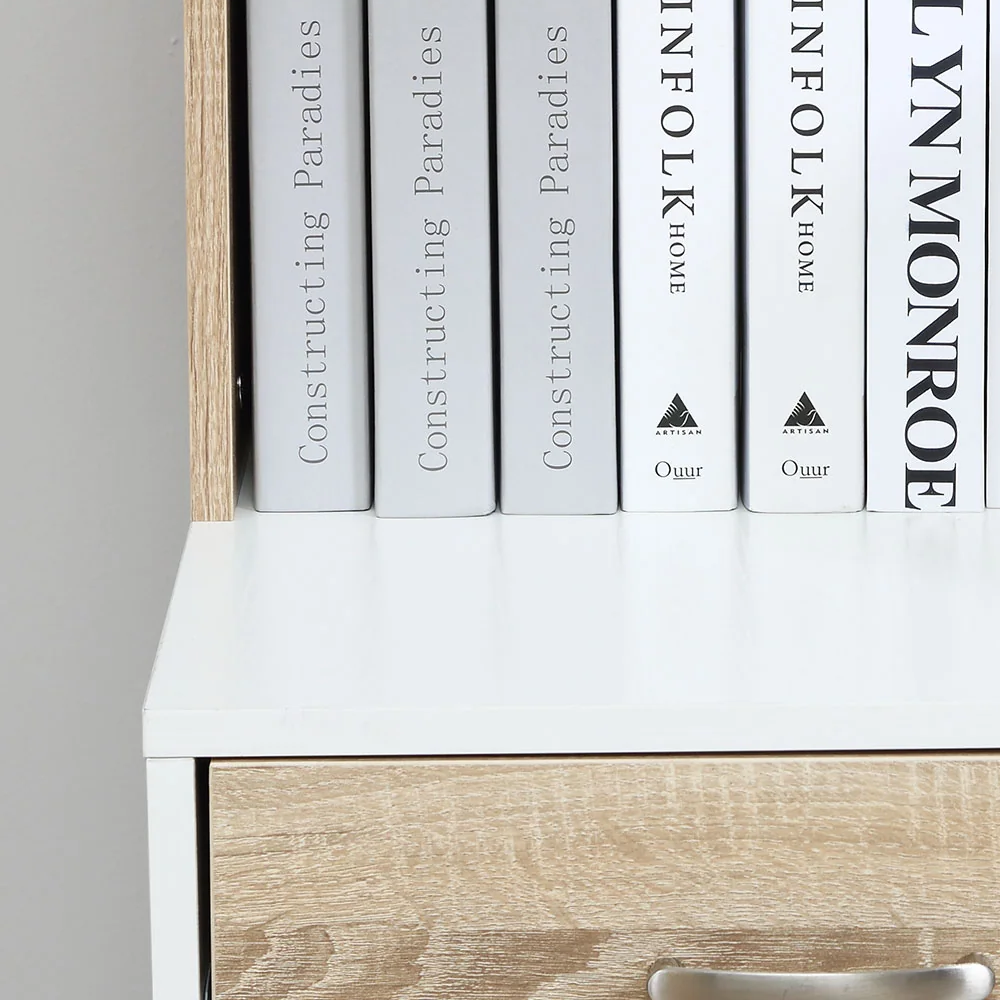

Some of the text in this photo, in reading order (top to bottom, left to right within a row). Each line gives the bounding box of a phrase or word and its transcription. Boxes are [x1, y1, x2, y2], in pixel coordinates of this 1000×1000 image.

[292, 21, 329, 463] Constructing Paradies
[412, 27, 450, 471] Constructing Paradies
[538, 27, 575, 469] Constructing Paradies
[670, 224, 685, 293] HOME
[798, 222, 814, 292] HOME
[905, 169, 961, 510] MONROE
[655, 461, 703, 478] Ouur
[782, 460, 830, 478] Ouur
